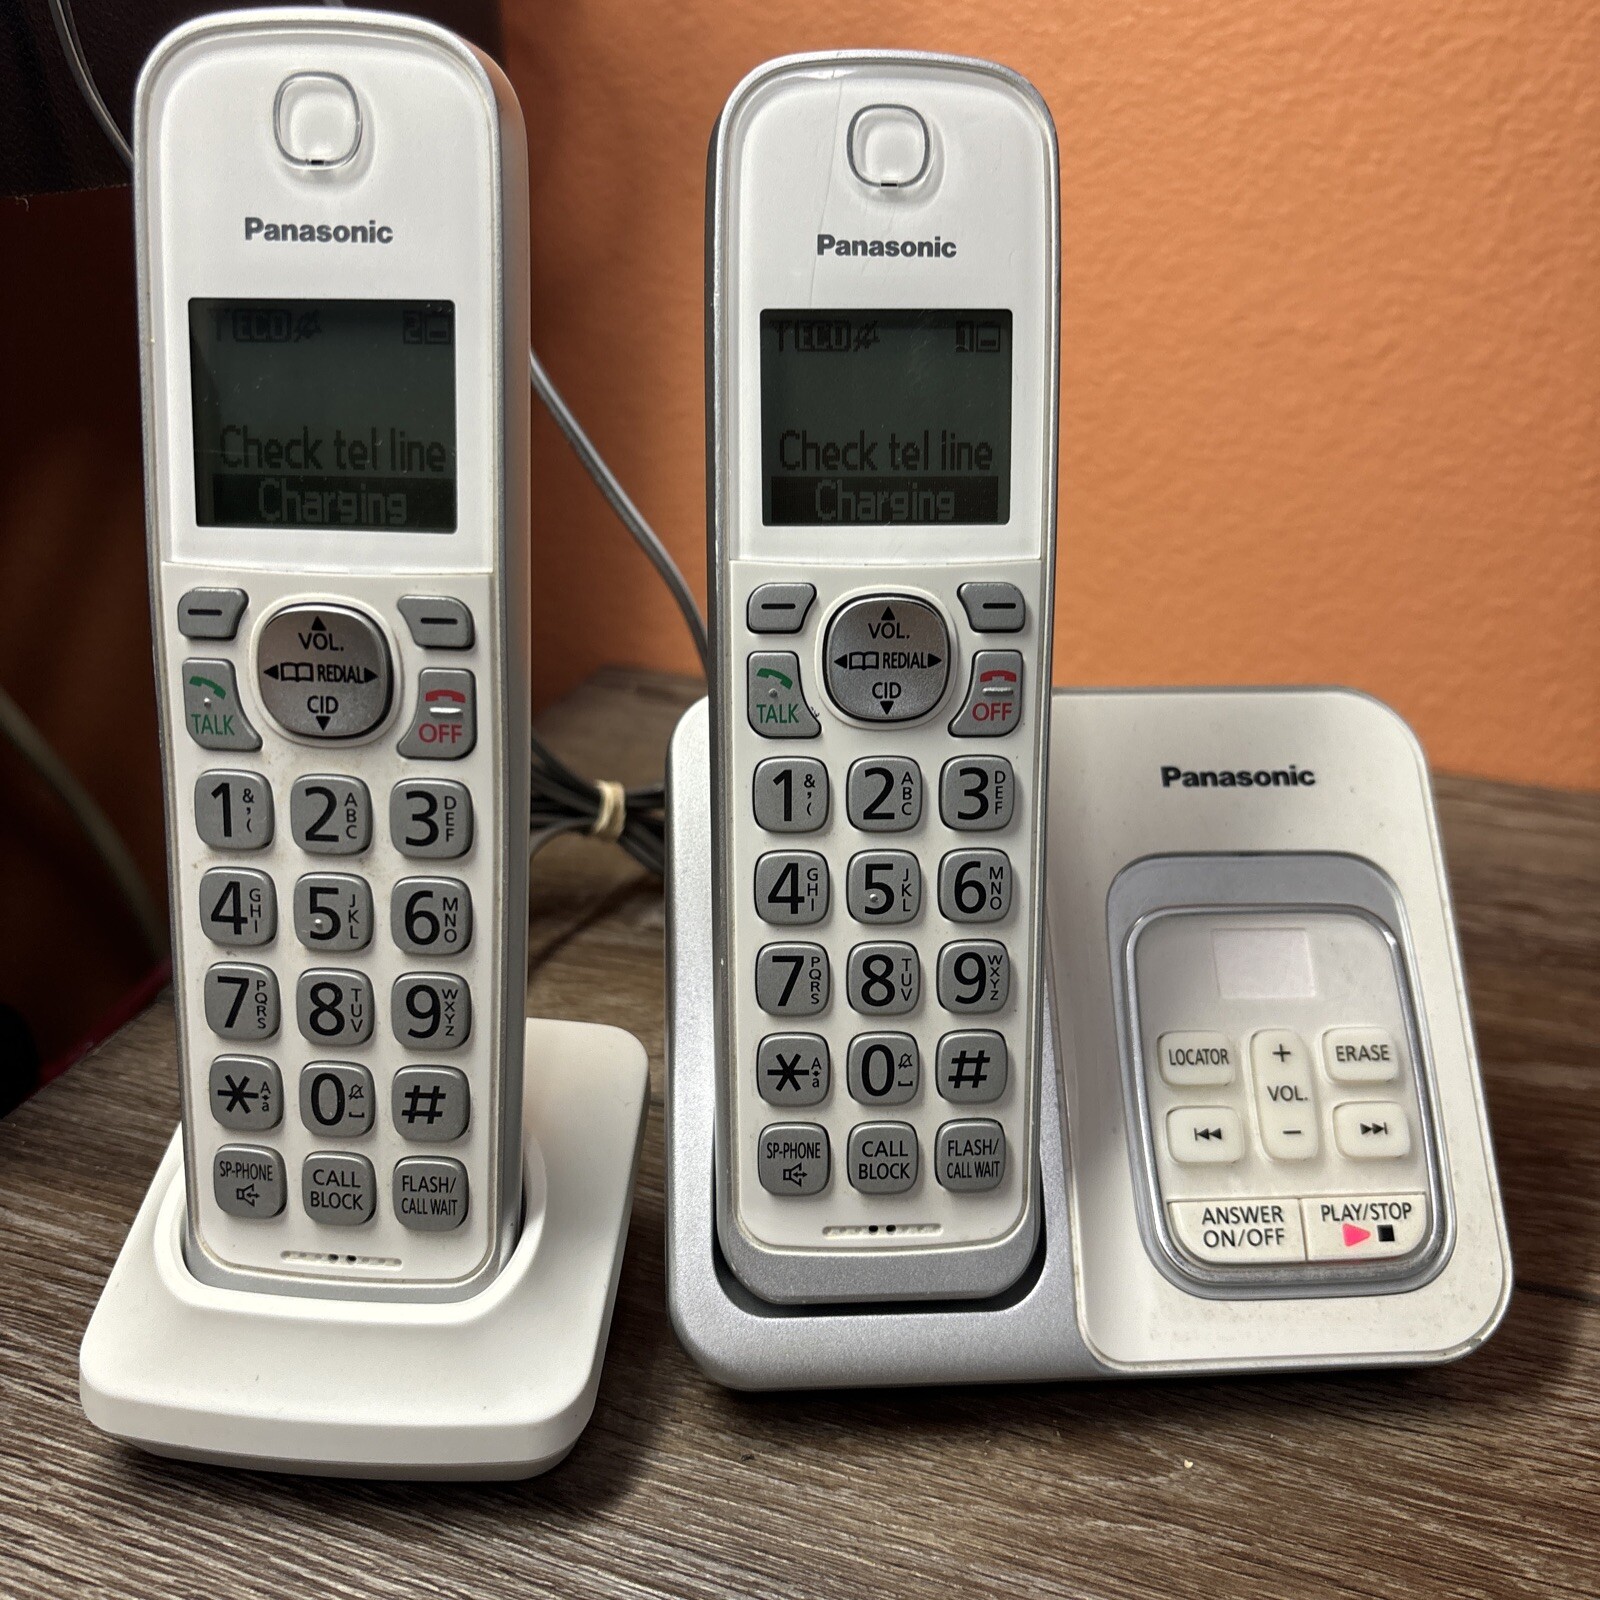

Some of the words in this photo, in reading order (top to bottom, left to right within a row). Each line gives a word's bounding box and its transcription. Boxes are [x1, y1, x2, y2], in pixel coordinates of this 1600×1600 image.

[245, 217, 394, 244] Panasonic
[817, 234, 957, 258] Panasonic
[220, 425, 323, 469] Check
[334, 427, 378, 470] tel
[390, 427, 446, 472] line
[780, 430, 878, 470] Check
[888, 430, 928, 470] tel
[941, 430, 993, 470] line
[258, 478, 408, 525] Charging
[815, 479, 956, 521] Charging
[298, 633, 344, 652] VOL.
[868, 622, 910, 639] VOL.
[882, 652, 927, 669] REDIAL
[317, 664, 364, 684] REDIAL
[871, 682, 902, 699] CID
[307, 695, 338, 715] CID
[756, 703, 799, 724] TALK
[972, 702, 1013, 721] OFF
[191, 714, 235, 736] TALK
[418, 724, 463, 744] OFF
[1161, 765, 1317, 788] Panasonic
[772, 769, 792, 822] 1
[863, 767, 895, 820] 2
[957, 767, 989, 820] 3
[211, 782, 232, 838] 1
[305, 786, 339, 842] 2
[405, 790, 439, 847] 3
[767, 862, 805, 915] 4
[864, 863, 895, 915] 5
[954, 861, 987, 914] 6
[210, 881, 248, 935] 4
[309, 886, 341, 941] 5
[404, 890, 440, 945] 6
[771, 955, 805, 1007] 7
[861, 954, 895, 1007] 8
[953, 951, 987, 1004] 9
[217, 976, 249, 1028] 7
[309, 982, 345, 1036] 8
[405, 984, 441, 1039] 9
[1168, 1048, 1229, 1066] LOCATOR
[1335, 1044, 1390, 1062] ERASE
[861, 1044, 895, 1097] 0
[948, 1050, 990, 1089] #
[310, 1073, 345, 1126] 0
[401, 1085, 446, 1124] #
[1267, 1085, 1308, 1101] VOL.
[766, 1142, 821, 1160] SP-PHONE
[861, 1140, 909, 1157] CALL
[947, 1138, 999, 1157] FLASH/
[219, 1160, 273, 1182] SP-PHONE
[312, 1169, 361, 1188] CALL
[858, 1163, 910, 1180] BLOCK
[946, 1162, 973, 1179] CALL
[974, 1161, 1000, 1178] WAIT
[402, 1175, 456, 1194] FLASH/
[310, 1191, 363, 1211] BLOCK
[401, 1198, 429, 1215] CALL
[430, 1199, 458, 1216] WAIT
[1320, 1202, 1412, 1222] PLAY/STOP
[1202, 1205, 1285, 1225] ANSWER
[1203, 1228, 1285, 1248] ON/OFF
